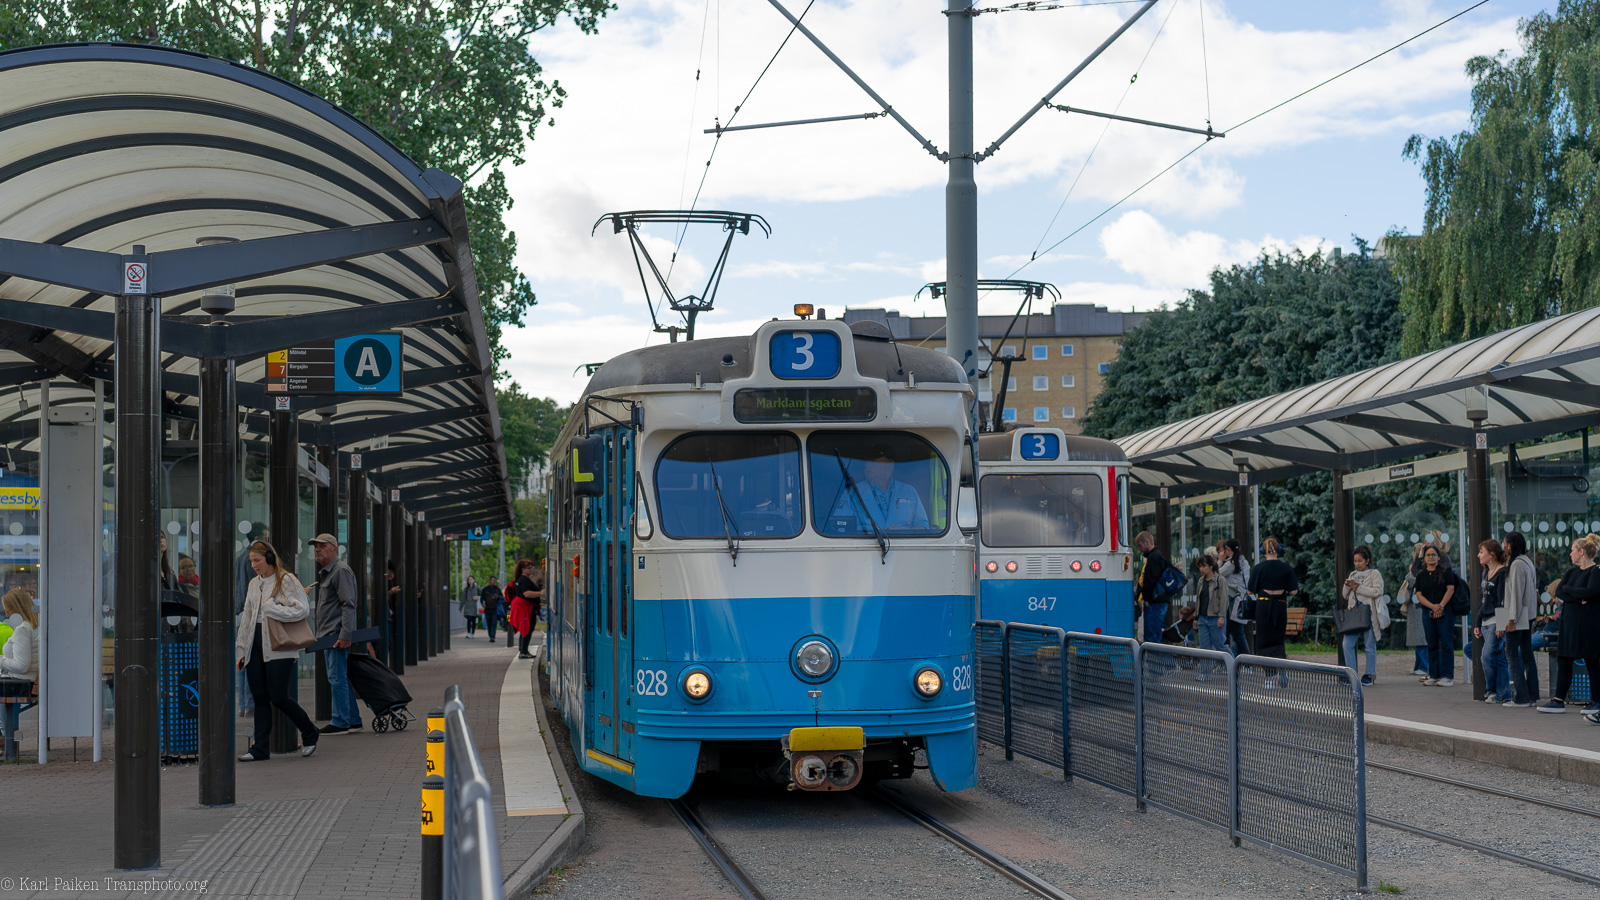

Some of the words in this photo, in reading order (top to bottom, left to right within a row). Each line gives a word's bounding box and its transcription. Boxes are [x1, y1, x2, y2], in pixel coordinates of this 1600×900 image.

[280, 351, 286, 360] 2
[791, 331, 815, 371] 3
[280, 365, 286, 375] 7
[355, 346, 381, 377] A
[1032, 434, 1046, 457] 3
[0, 491, 41, 508] essby
[474, 527, 483, 535] A
[1028, 597, 1057, 611] 847
[637, 668, 668, 696] 828
[952, 664, 972, 692] 828
